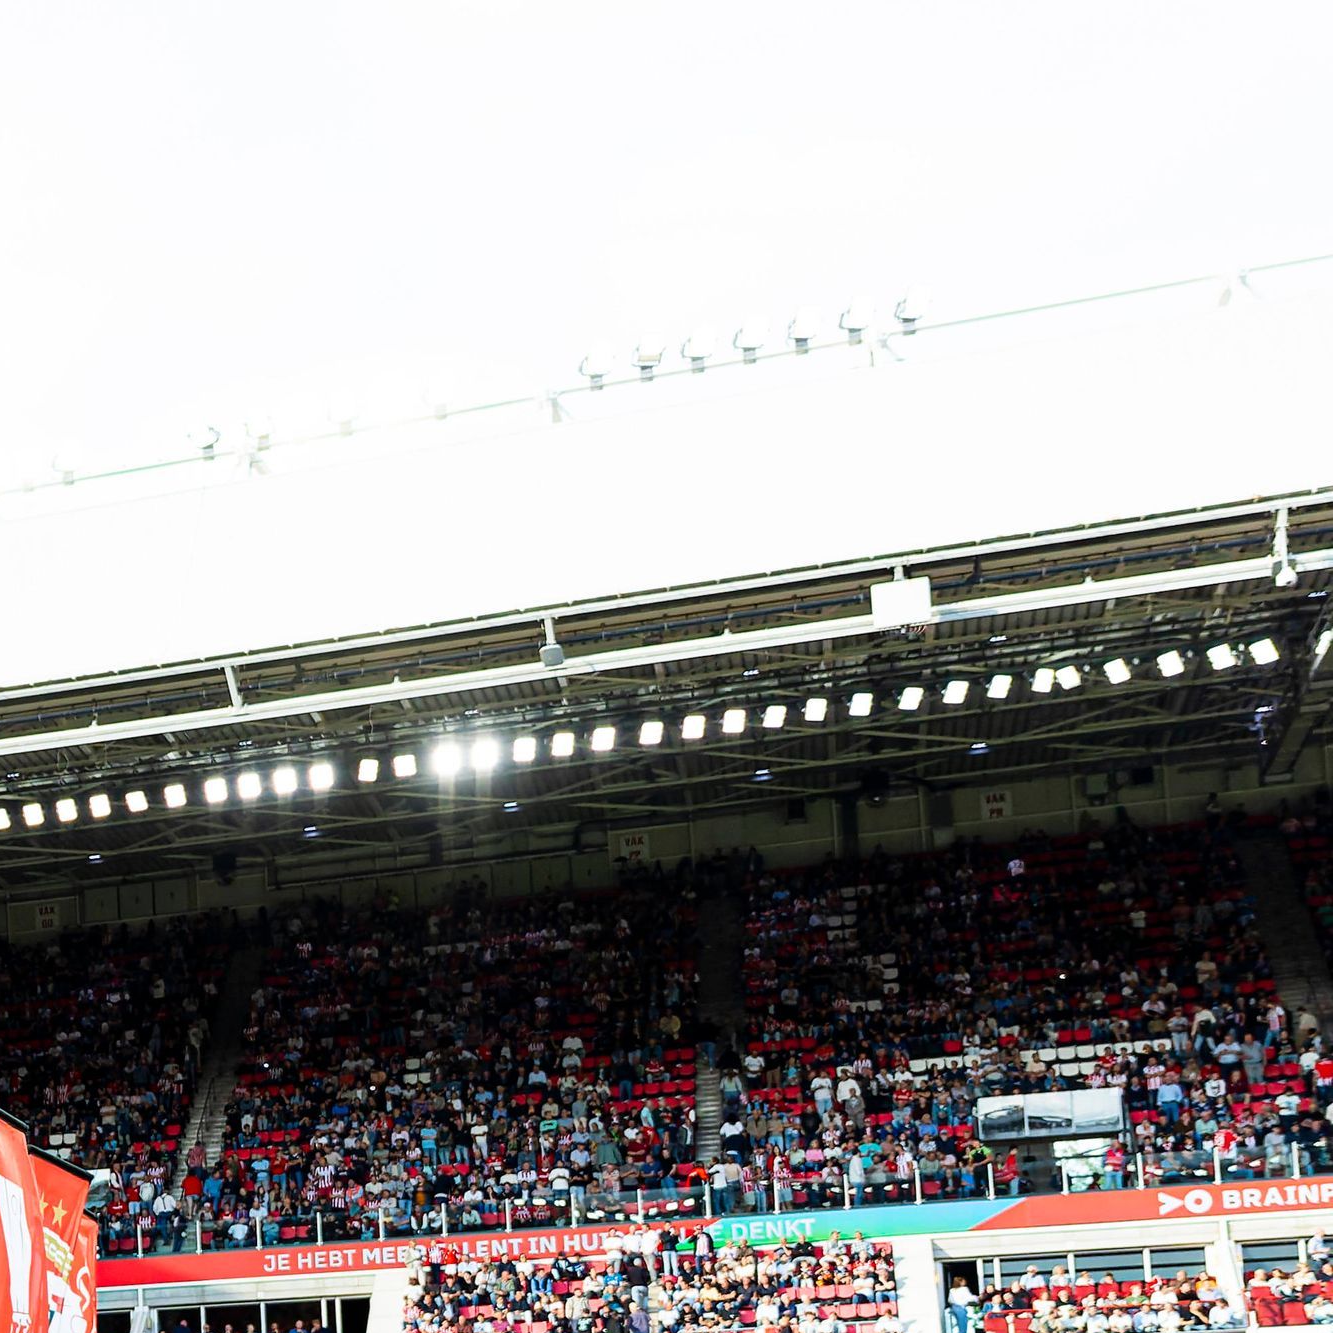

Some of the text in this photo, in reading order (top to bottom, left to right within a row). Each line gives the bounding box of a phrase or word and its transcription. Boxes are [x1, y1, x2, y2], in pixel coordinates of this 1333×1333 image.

[733, 1217, 817, 1241] DENKT
[263, 1253, 291, 1273] JE
[297, 1248, 357, 1270] HEBT
[527, 1236, 550, 1254] IN
